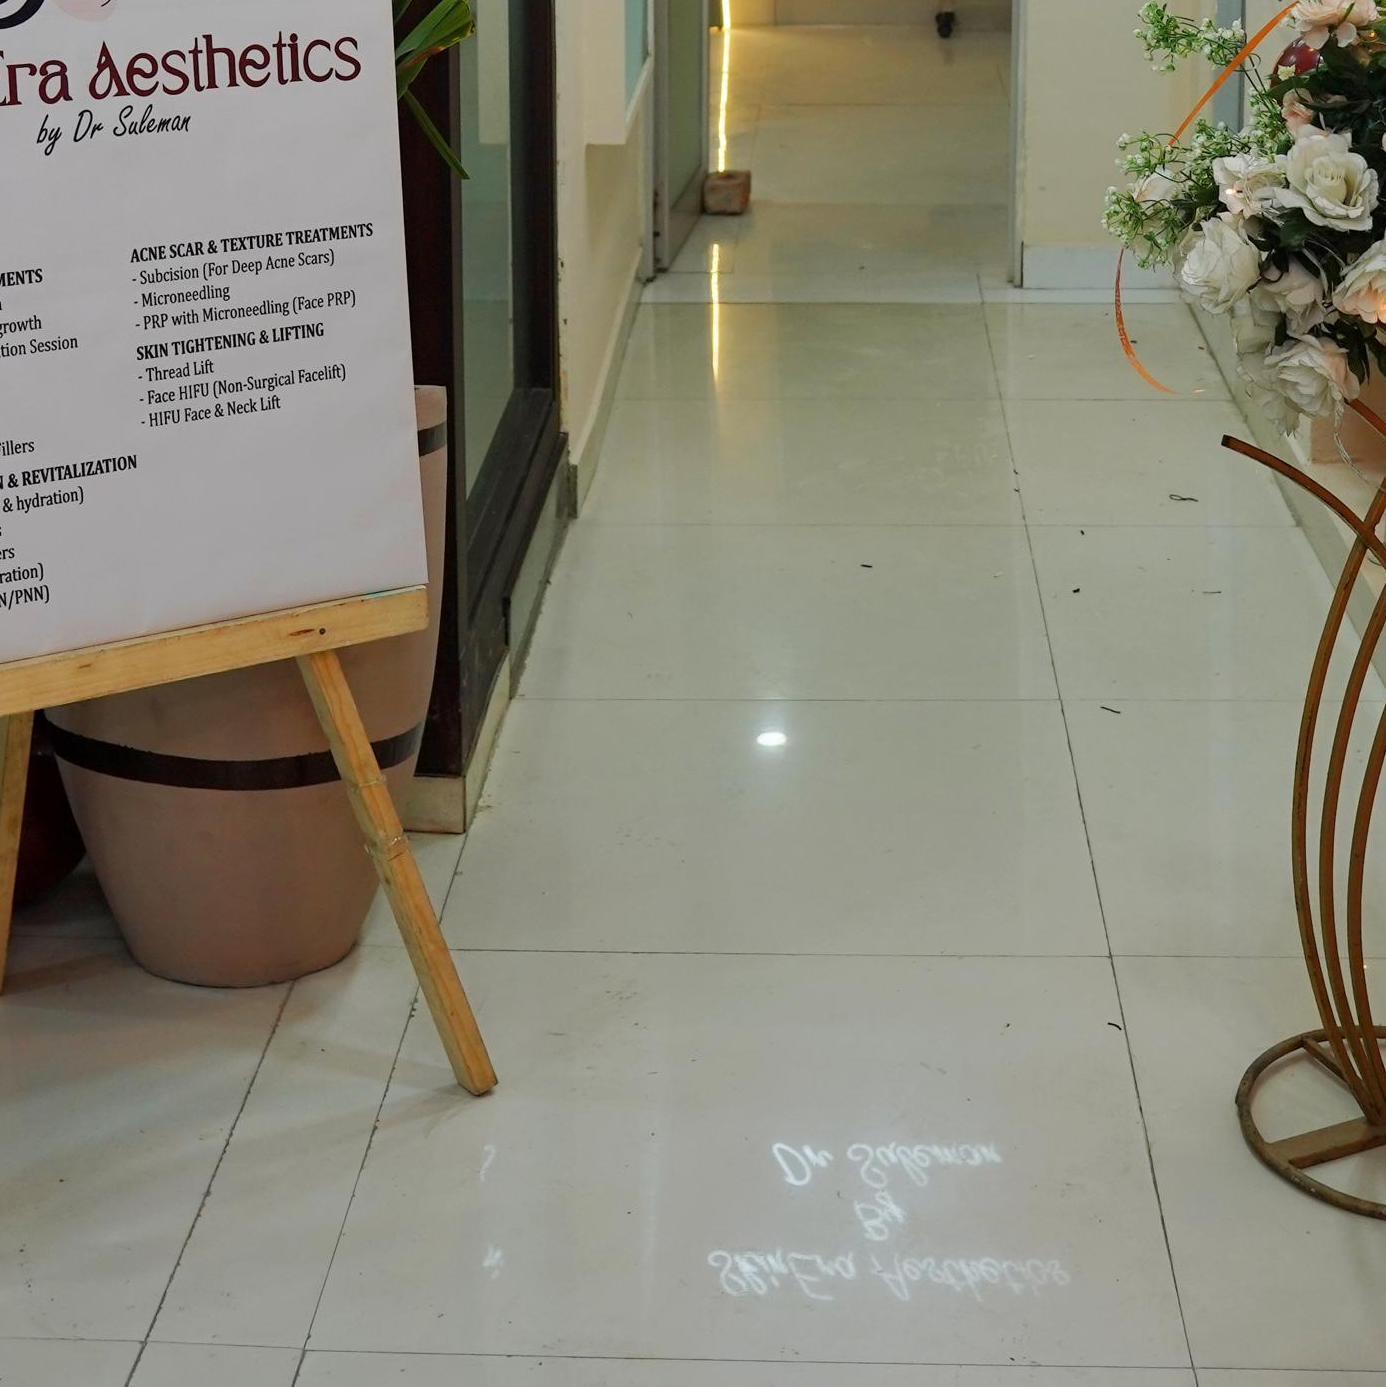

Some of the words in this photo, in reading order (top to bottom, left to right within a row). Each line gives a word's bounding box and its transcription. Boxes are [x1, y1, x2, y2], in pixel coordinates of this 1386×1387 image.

[88, 32, 362, 101] Aesthetics
[36, 113, 63, 156] by
[73, 108, 103, 143] Dr
[113, 103, 191, 138] Suleman
[130, 246, 167, 262] ACNE
[169, 242, 205, 258] SCAR
[207, 240, 218, 253] &
[220, 233, 283, 252] TEXTURE
[285, 223, 373, 244] TREATMENTS
[139, 267, 199, 284] Subcision
[202, 263, 229, 280] (For
[231, 260, 263, 274] Deep
[265, 256, 295, 269] Acne
[297, 249, 335, 266] Scars)
[141, 285, 230, 306] Microneedling
[143, 314, 168, 329] PRP
[171, 310, 199, 325] with
[202, 300, 290, 321] Microneedling
[292, 297, 324, 314] (Face
[327, 290, 356, 307] PRP)
[29, 337, 78, 353] Session
[136, 343, 168, 360] SKIN
[171, 332, 256, 355] TIGHTENING
[258, 330, 269, 343] &
[271, 323, 324, 342] LIFTING
[145, 362, 190, 381] Thread
[193, 359, 214, 375] Lift
[147, 390, 175, 404] Face
[178, 383, 209, 400] HIFU
[212, 370, 295, 398] (Non-Surgical
[297, 364, 346, 383] Facelift)
[148, 409, 180, 426] HIFU
[184, 408, 211, 421] Face
[214, 404, 224, 417] &
[226, 399, 258, 415] Neck
[260, 395, 281, 410] Lift
[7, 474, 19, 487] &
[21, 455, 137, 485] REVITALIZATION
[2, 498, 13, 512] &
[15, 486, 84, 513] hydration)
